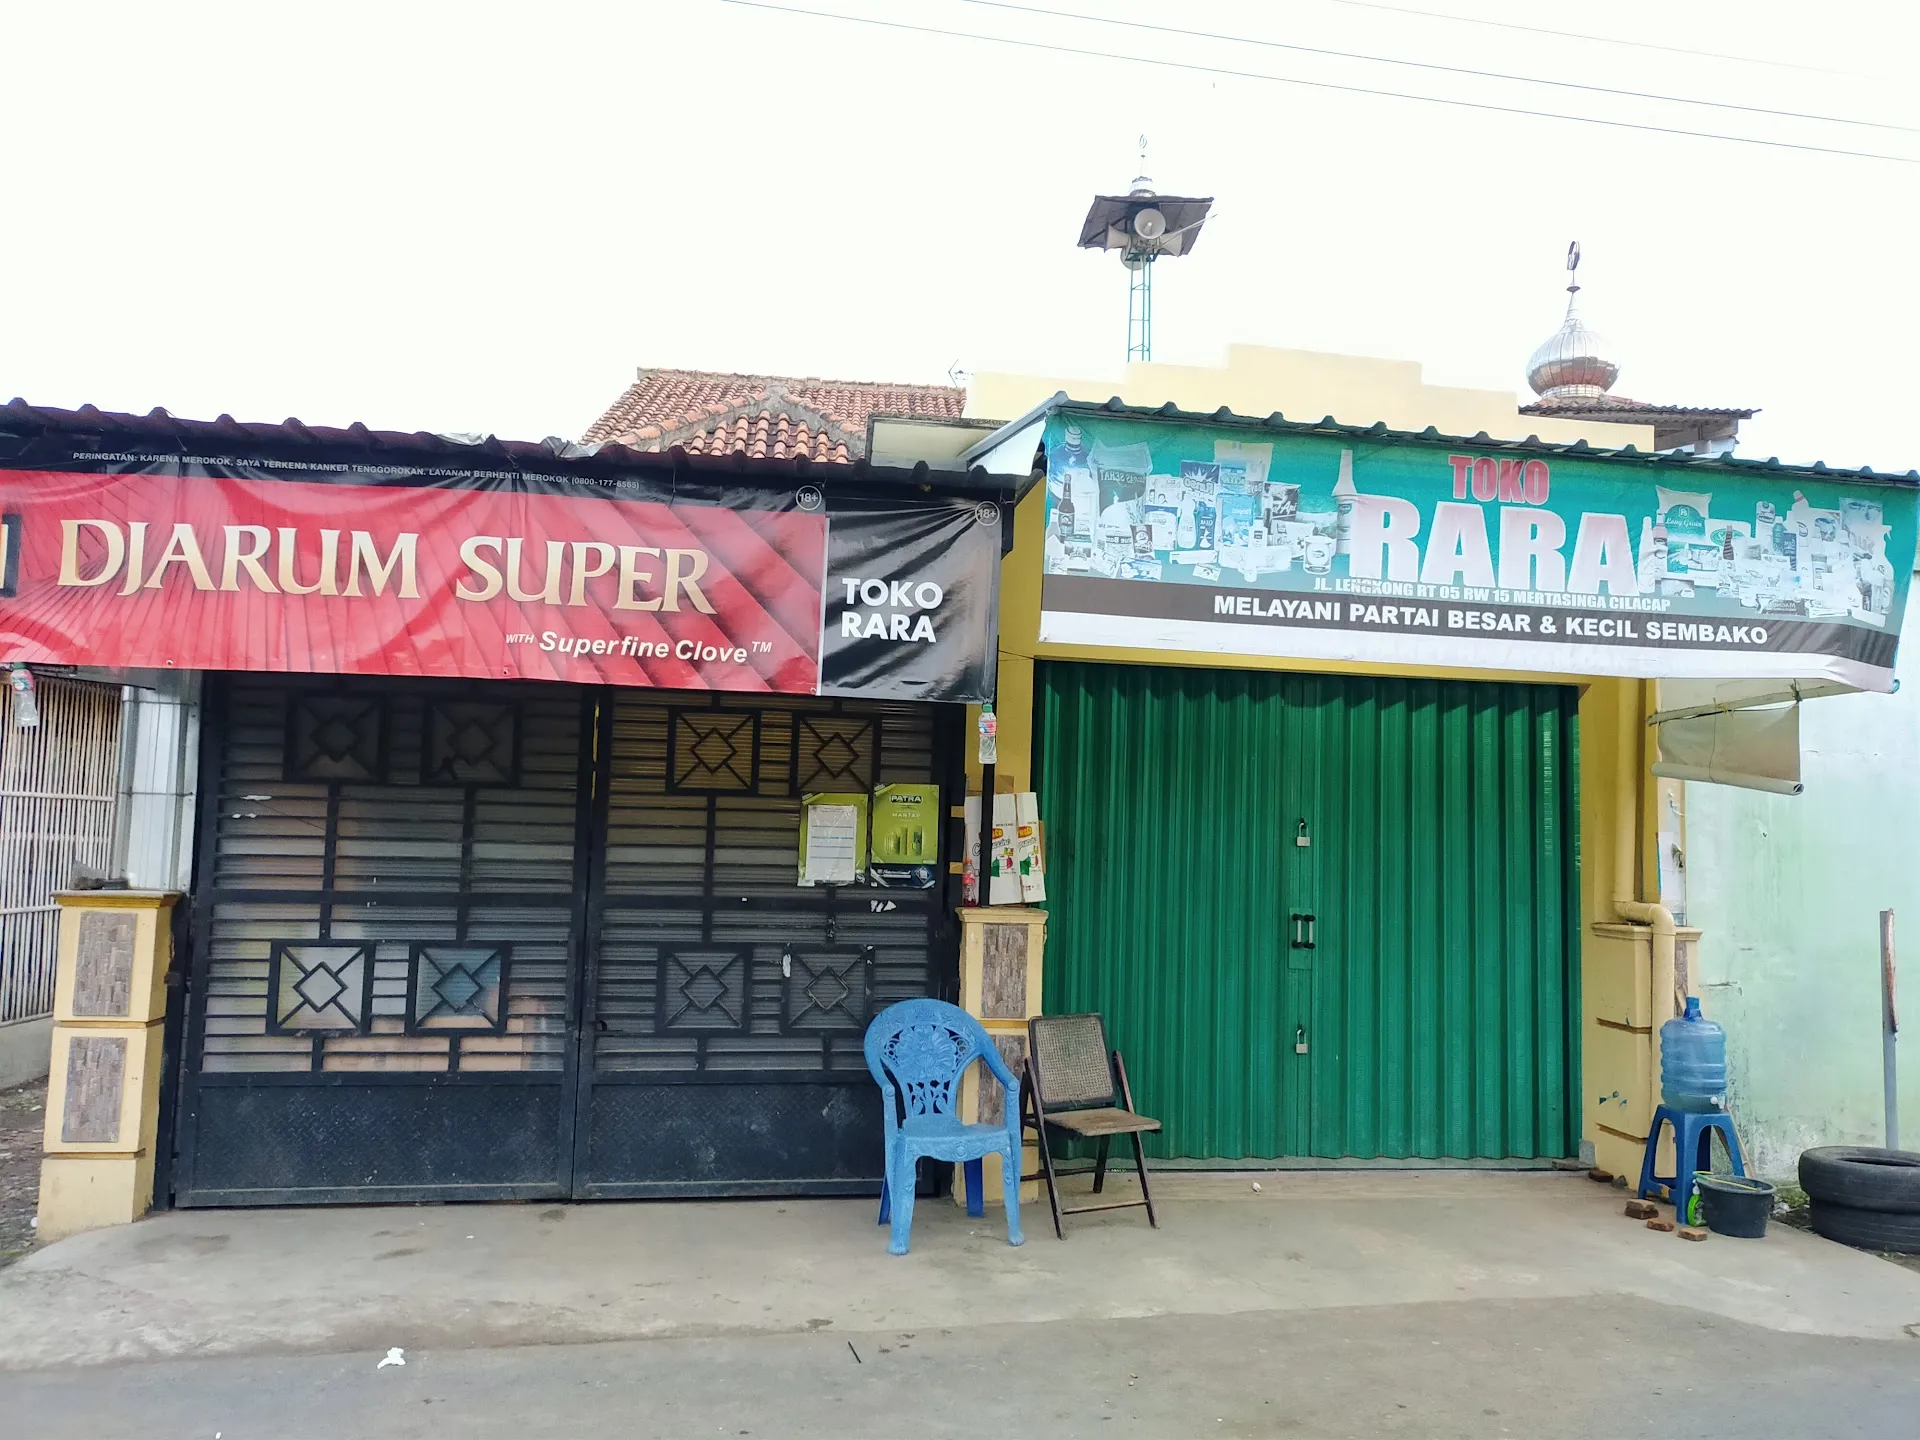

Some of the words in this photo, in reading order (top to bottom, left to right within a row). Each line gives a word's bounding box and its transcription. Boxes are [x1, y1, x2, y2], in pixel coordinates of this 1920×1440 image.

[72, 452, 138, 462] PERINGATAN:
[140, 454, 180, 463] KARENA
[182, 456, 234, 467] MEROKOK,
[236, 458, 261, 467] SAYA
[263, 460, 308, 470] TERKENA
[310, 462, 349, 472] KANKER
[352, 465, 427, 476] TENGGOROKAN.
[429, 469, 471, 478] LAYANAN
[473, 470, 520, 480] BERHENTI
[522, 473, 569, 484] MEROKOK
[571, 477, 640, 490] (0800-177-6565)
[1448, 454, 1550, 506] TOKO
[799, 491, 819, 503] 18+
[977, 508, 998, 519] 18+
[1349, 493, 1641, 597] RARA
[57, 518, 424, 599] DJARUM
[456, 534, 718, 615] SUPER
[842, 577, 943, 610] TOKO
[1313, 577, 1332, 592] JL.
[1335, 578, 1414, 597] LENGKONG
[1416, 584, 1438, 599] RT
[1441, 585, 1461, 600] 05
[1463, 588, 1489, 602] RW
[1492, 590, 1511, 603] 15
[1513, 590, 1607, 609] MERTASINGA
[1609, 596, 1671, 612] CILACAP
[841, 611, 937, 643] RARA
[1214, 595, 1341, 621] MELAYANI
[1349, 604, 1439, 628] PARTAI
[1447, 610, 1532, 633] BESAR
[1539, 615, 1557, 634] &
[1565, 616, 1638, 640] KECIL
[1645, 622, 1769, 646] SEMBAKO
[505, 633, 535, 644] WITH
[539, 630, 670, 658] Superfine
[674, 638, 748, 663] Clove
[891, 794, 922, 803] PATRA
